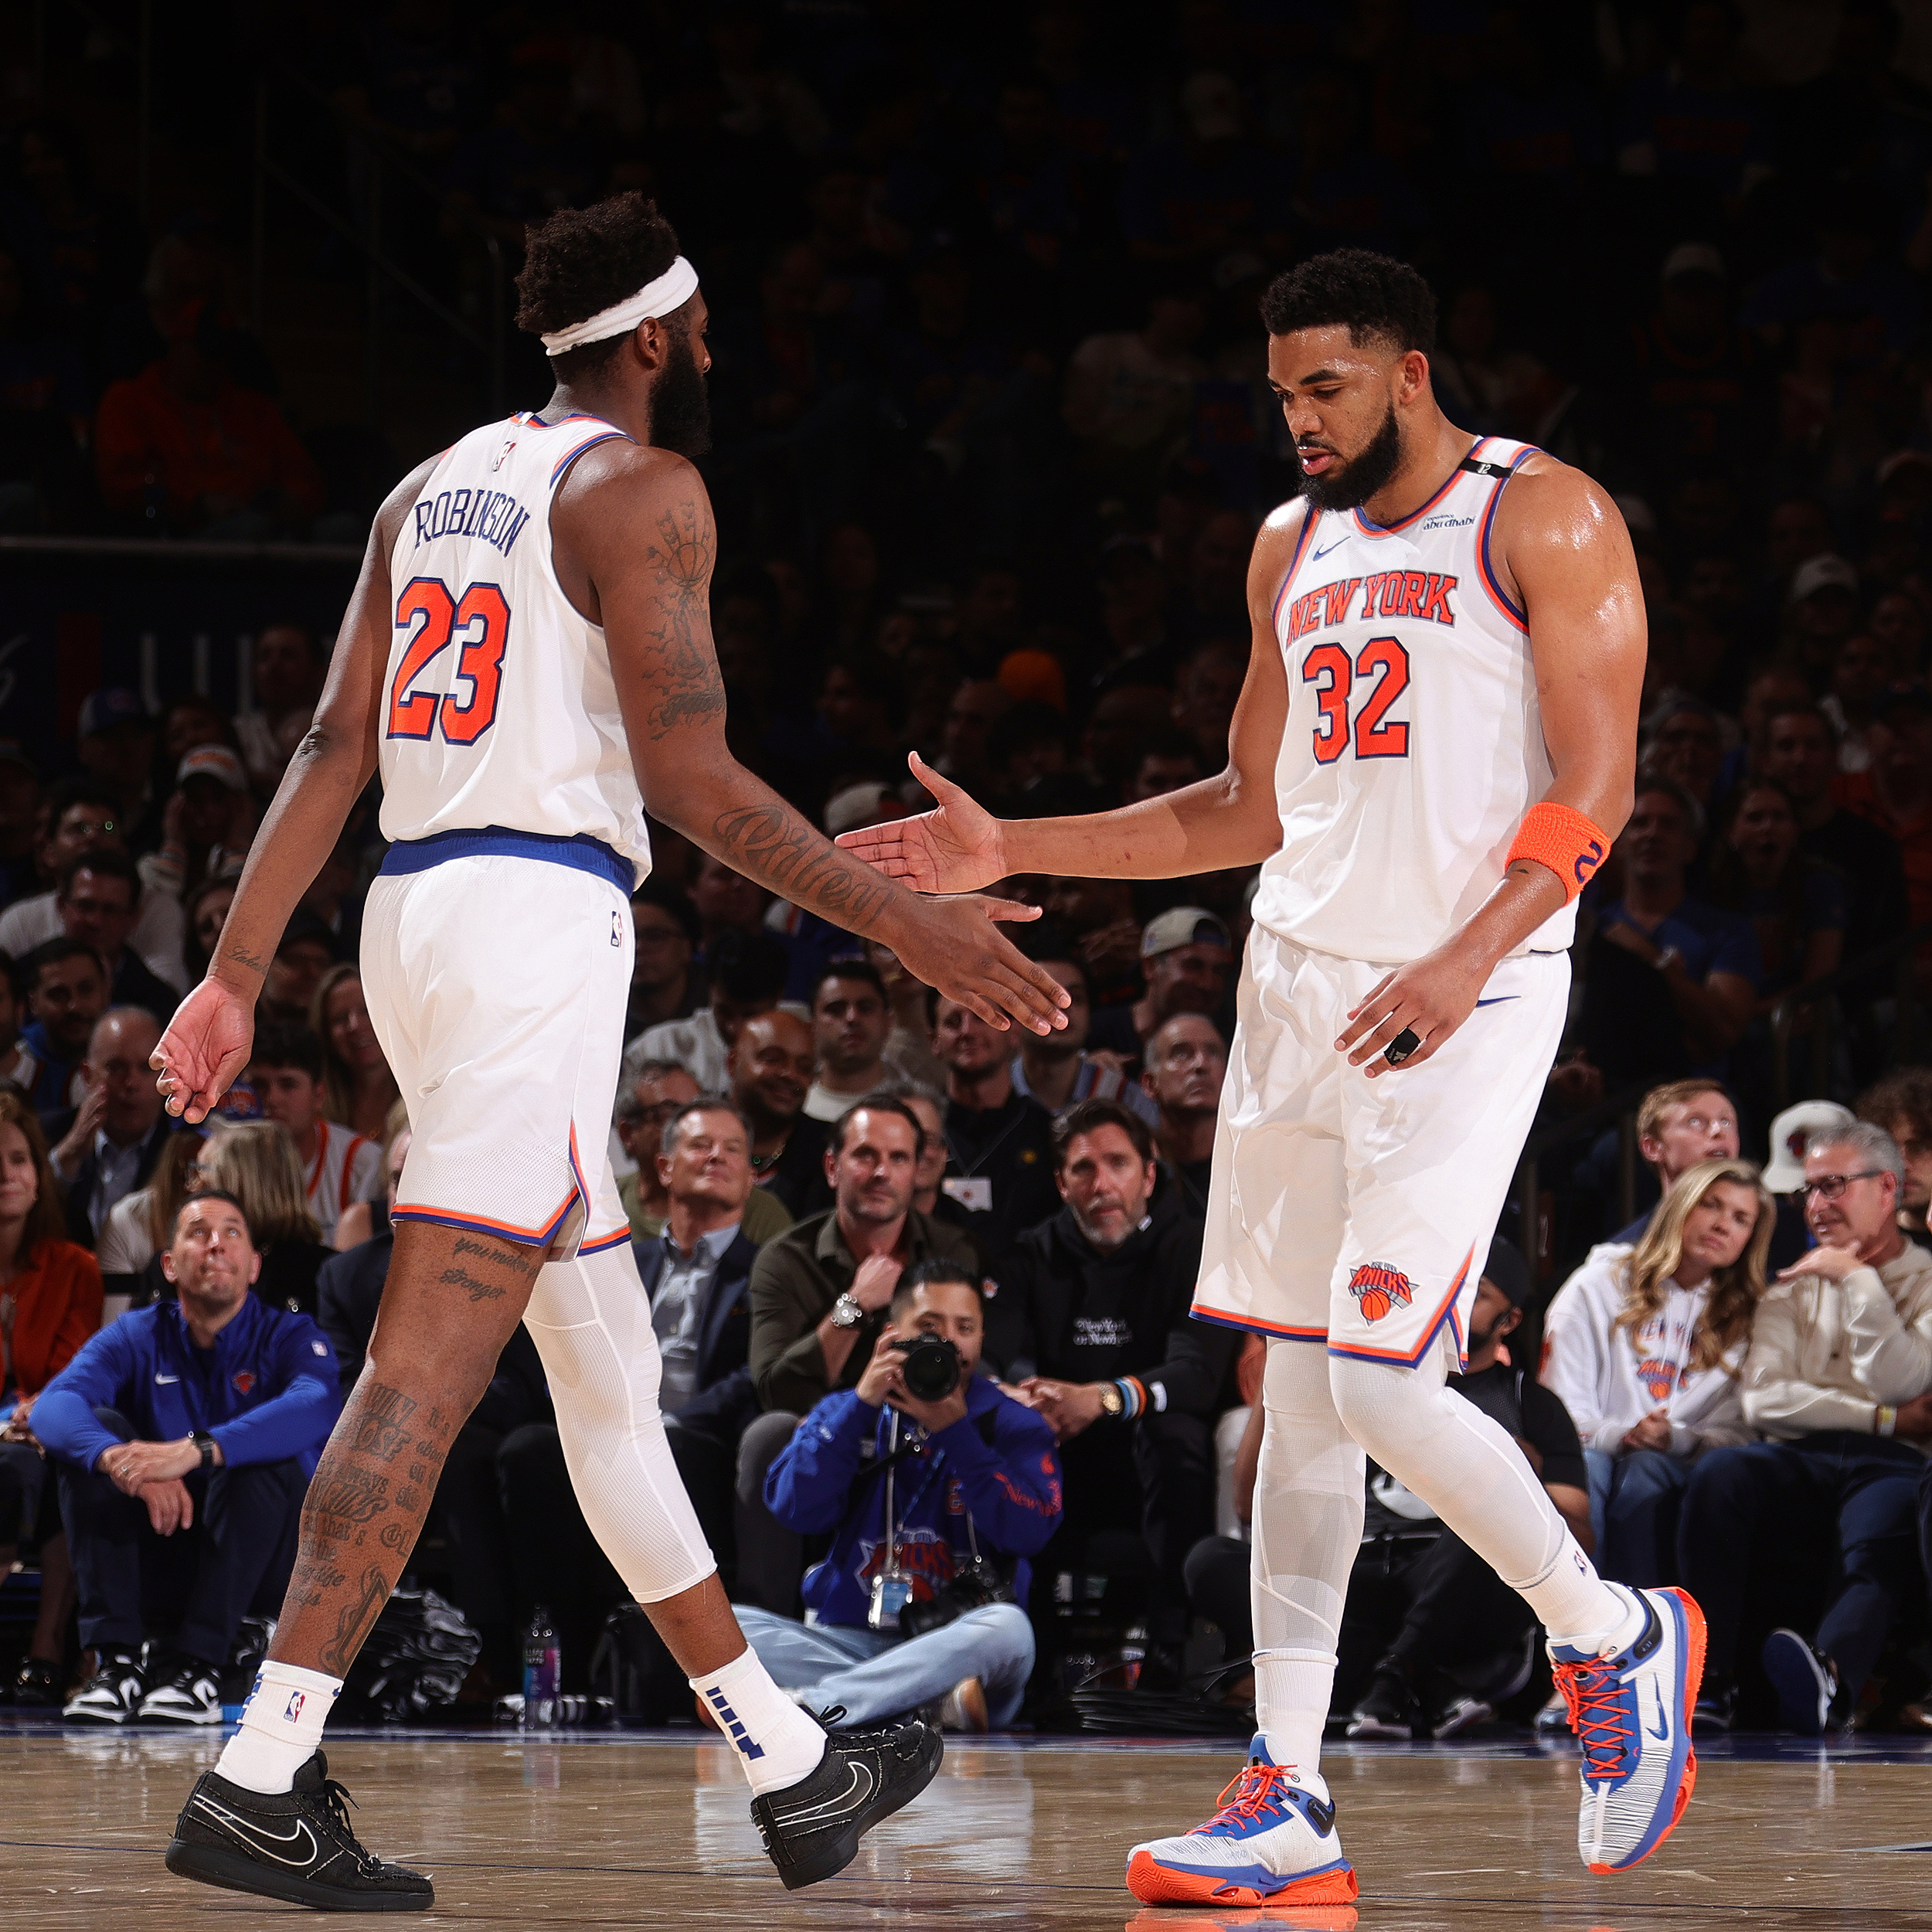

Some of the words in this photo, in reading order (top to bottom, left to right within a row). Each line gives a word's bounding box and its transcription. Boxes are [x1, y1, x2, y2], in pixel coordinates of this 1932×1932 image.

[414, 488, 531, 559] ROBINSON
[1423, 520, 1443, 531] abu
[1444, 515, 1477, 528] dhabi
[1285, 577, 1362, 654] NEW
[1359, 570, 1459, 628] YORK
[386, 576, 512, 747] 23
[1302, 635, 1411, 766] 32
[1348, 1264, 1413, 1304] KNICKS
